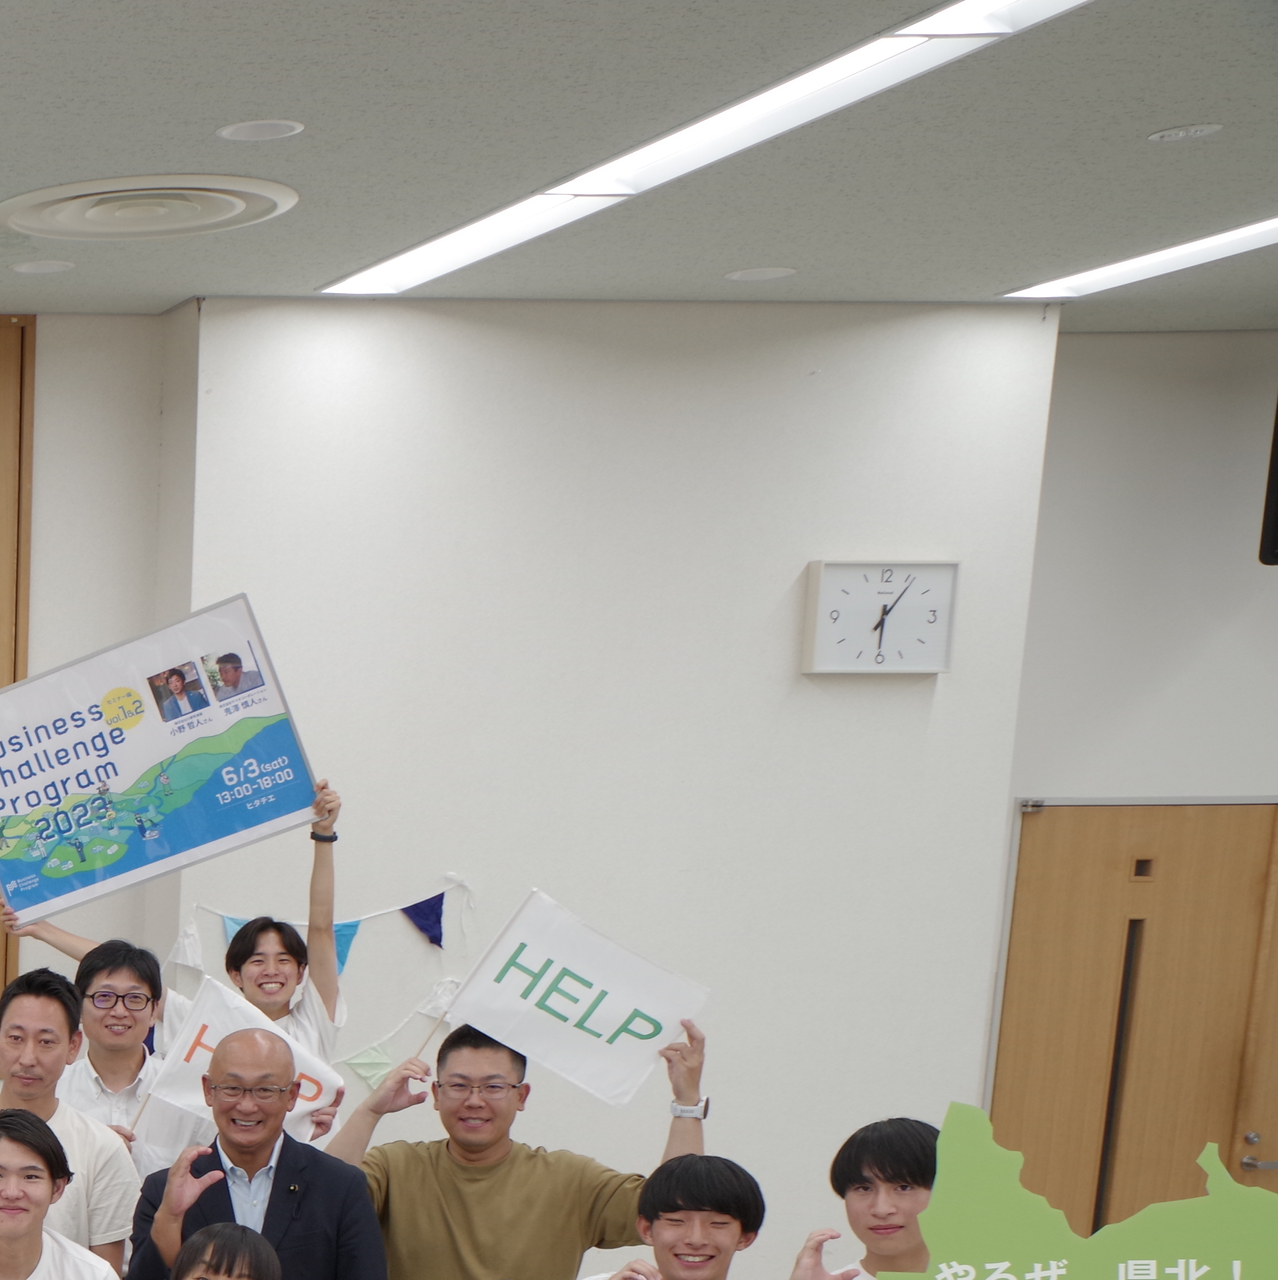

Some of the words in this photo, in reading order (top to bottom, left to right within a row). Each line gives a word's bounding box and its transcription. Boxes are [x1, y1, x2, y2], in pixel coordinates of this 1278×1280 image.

[880, 568, 894, 583] 12
[829, 609, 840, 624] 9
[927, 609, 938, 624] 3
[874, 650, 885, 664] 6
[105, 699, 146, 726] vol.1&2
[215, 768, 295, 805] 13:00-18:00
[246, 794, 276, 810] ヒタチエ
[34, 796, 111, 842] 2023
[493, 942, 663, 1045] HELP
